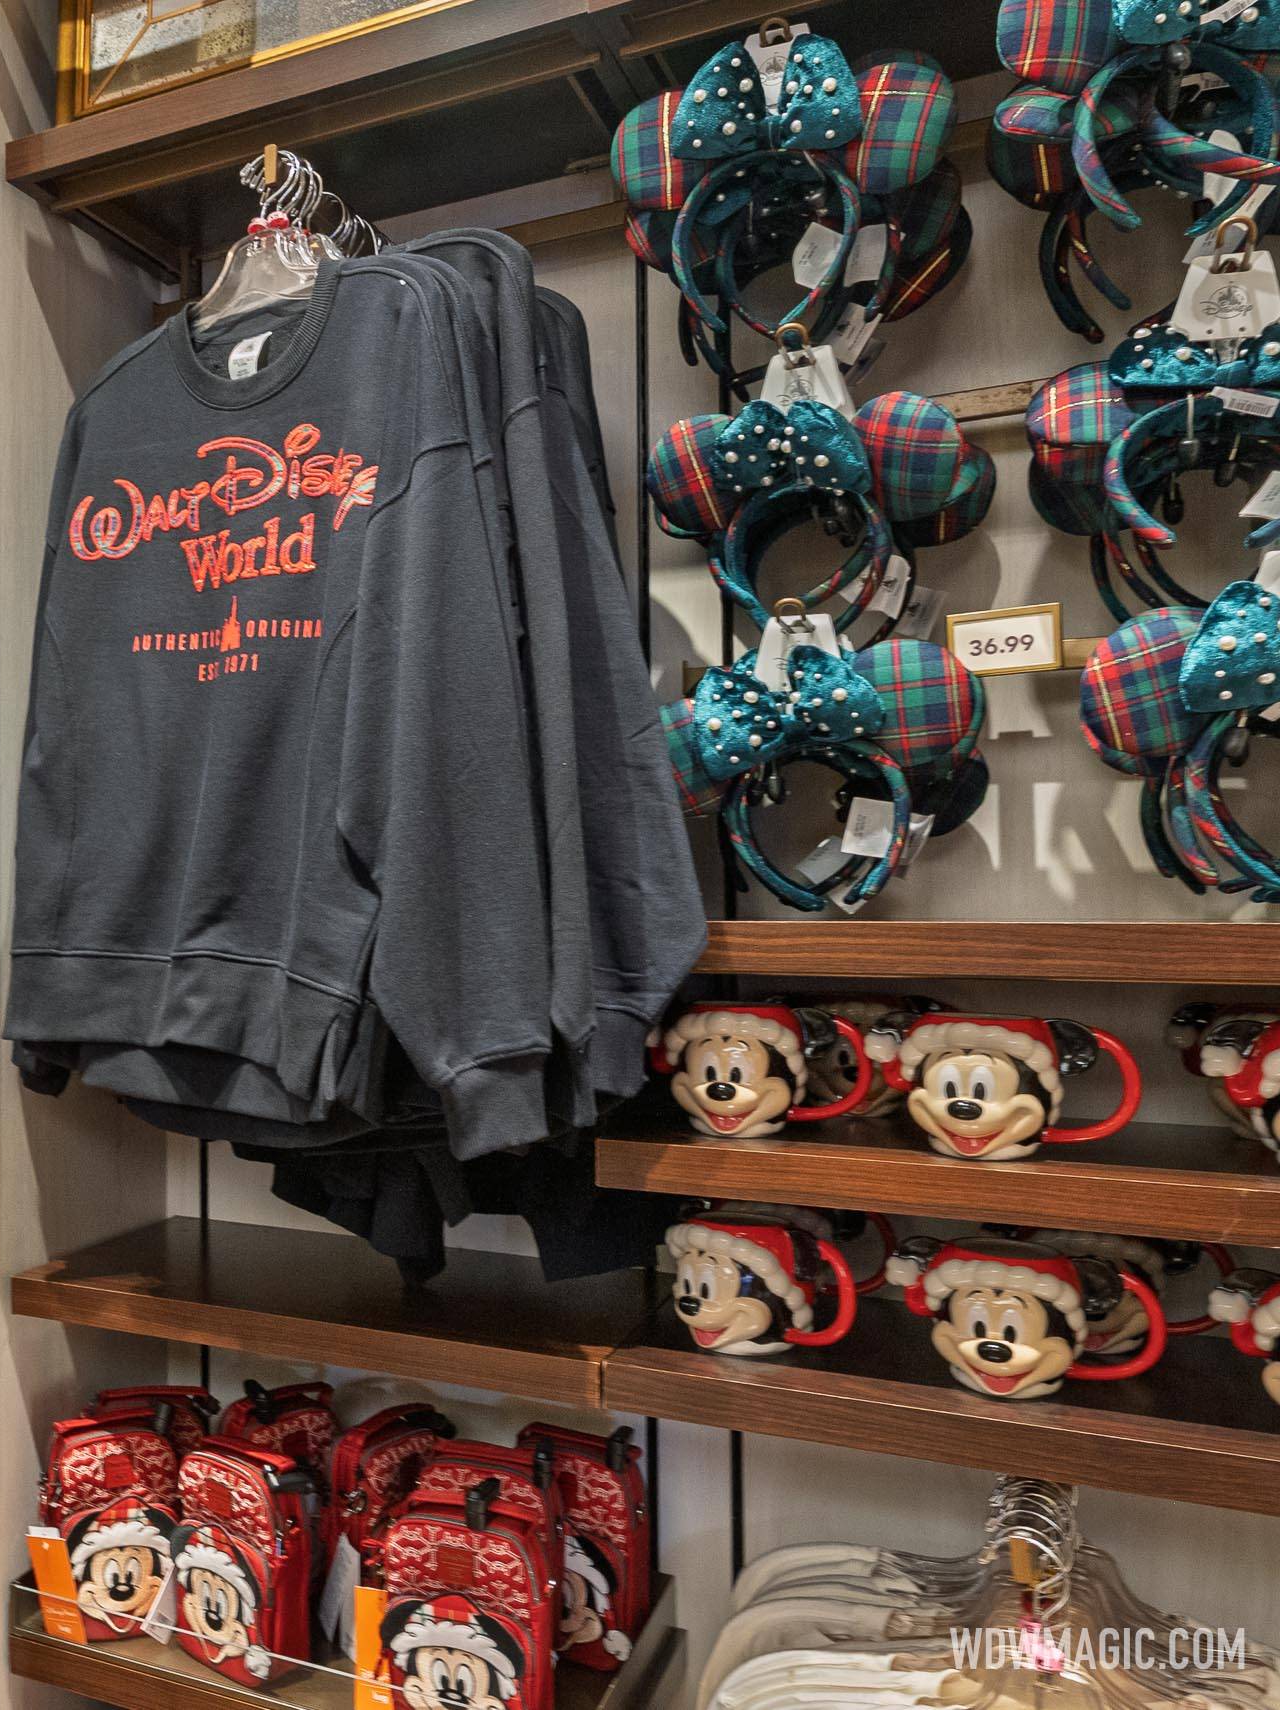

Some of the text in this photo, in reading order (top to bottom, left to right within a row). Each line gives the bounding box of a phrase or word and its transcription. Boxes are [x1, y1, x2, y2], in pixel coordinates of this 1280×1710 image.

[180, 513, 318, 593] World
[969, 634, 1034, 657] 36.99
[224, 652, 259, 674] 1971
